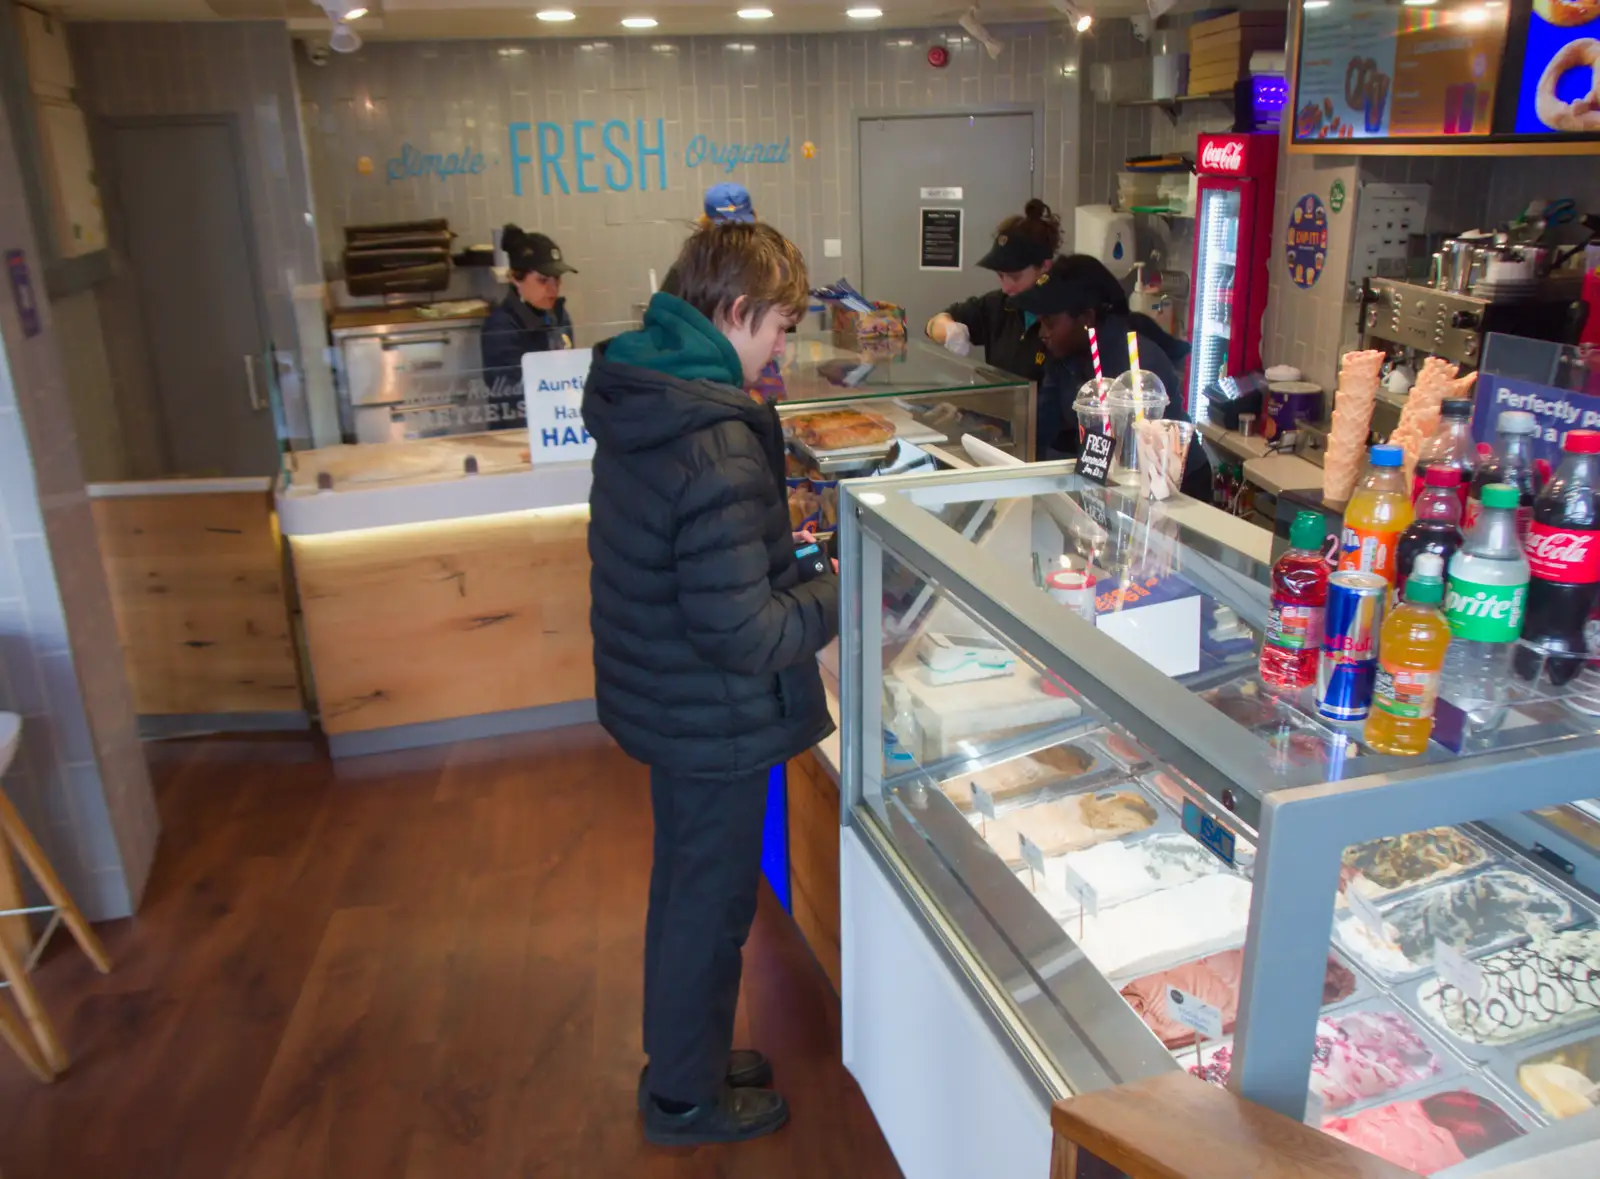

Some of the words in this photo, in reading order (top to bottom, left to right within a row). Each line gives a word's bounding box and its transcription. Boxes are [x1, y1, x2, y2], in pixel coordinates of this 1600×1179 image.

[387, 142, 487, 185] Simple
[508, 118, 668, 196] FRESH
[685, 134, 791, 174] Original
[536, 375, 584, 393] Aunti
[554, 405, 580, 420] Ha
[1495, 387, 1581, 424] Perfectly
[1085, 433, 1112, 457] FRESH
